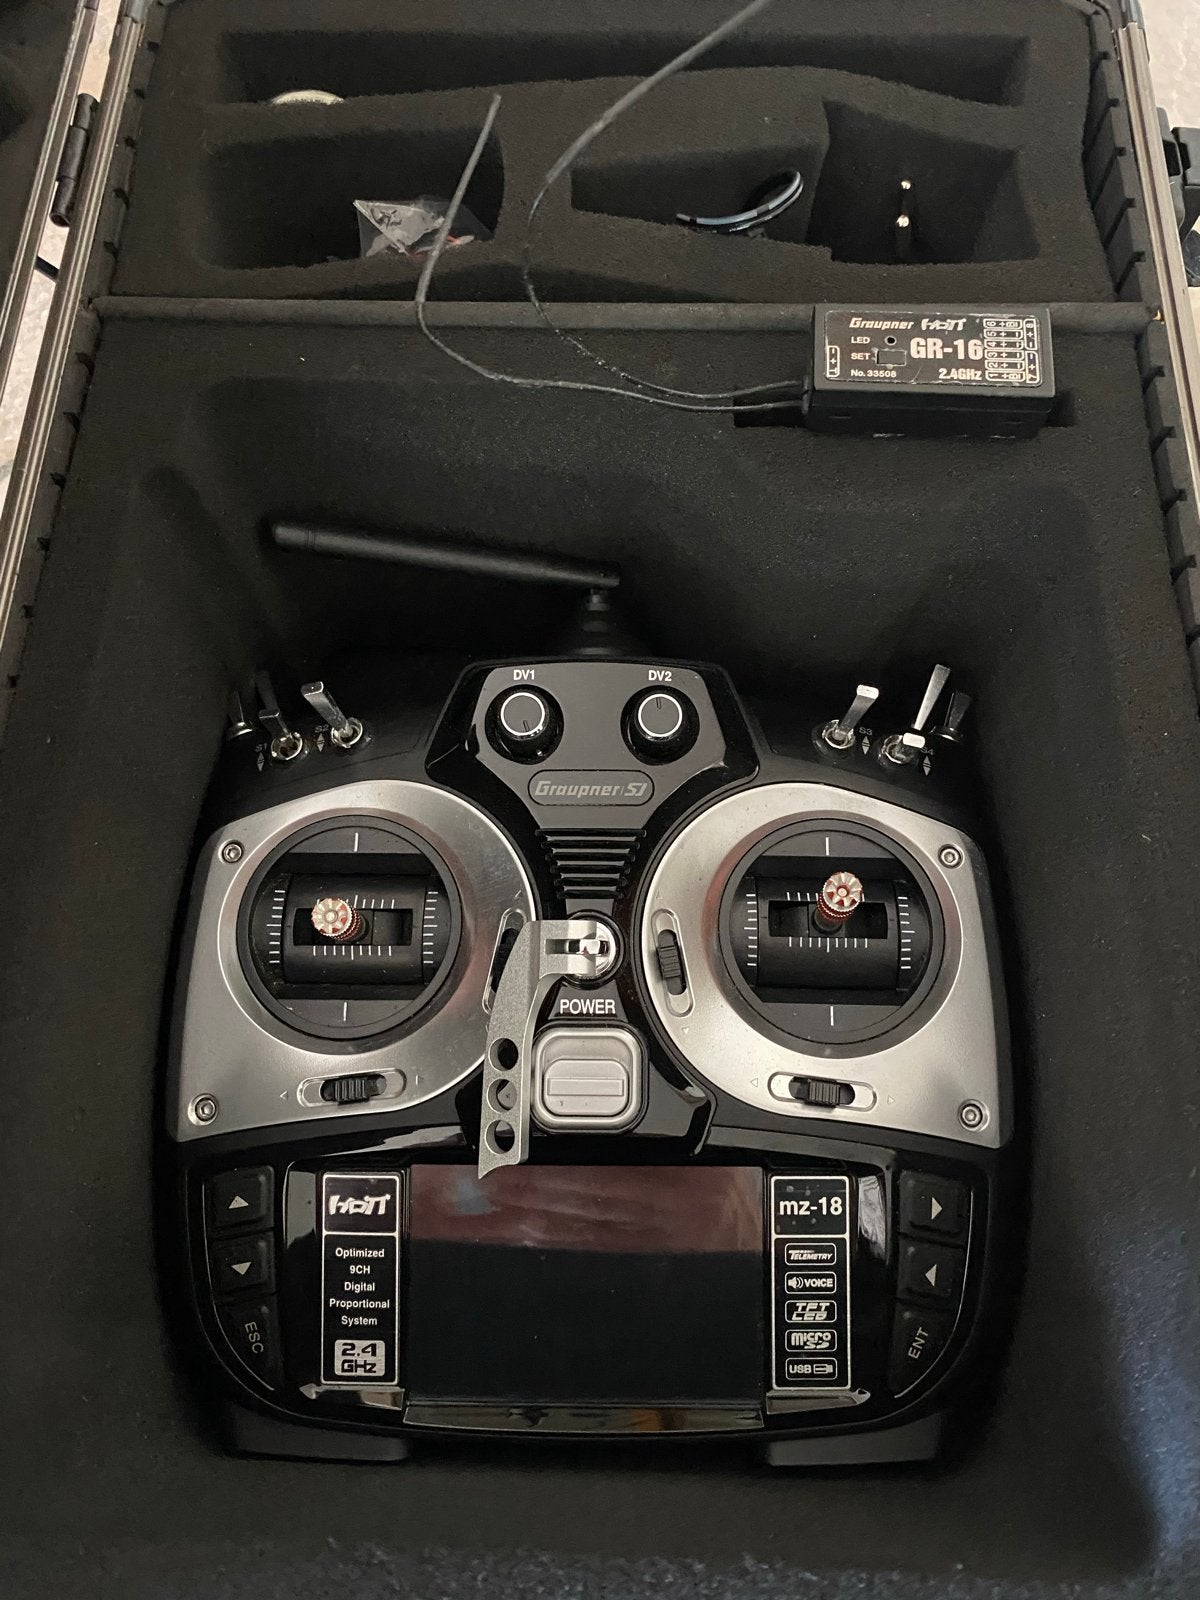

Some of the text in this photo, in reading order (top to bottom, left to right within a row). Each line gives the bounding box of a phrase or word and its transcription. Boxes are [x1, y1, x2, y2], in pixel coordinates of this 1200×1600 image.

[849, 317, 914, 331] Graupner
[851, 336, 871, 344] LED
[910, 337, 983, 360] GR-16
[851, 352, 871, 360] SET
[867, 370, 897, 378] 33508
[938, 368, 982, 381] 2.4GHz
[513, 669, 535, 681] DV1
[648, 670, 672, 682] DV2
[859, 726, 873, 736] S3
[534, 780, 621, 798] Graupner
[560, 998, 616, 1015] POWER
[779, 1196, 843, 1216] mz-18
[335, 1247, 385, 1259] Optimized
[349, 1265, 371, 1275] 9CH
[344, 1282, 376, 1293] Digital
[804, 1278, 834, 1288] VOICE
[329, 1298, 390, 1310] Proportional
[341, 1315, 378, 1327] System
[244, 1321, 264, 1354] ESC
[907, 1326, 929, 1360] ENT
[341, 1343, 377, 1357] 2.4
[340, 1359, 377, 1374] GHz
[788, 1364, 812, 1374] USB
